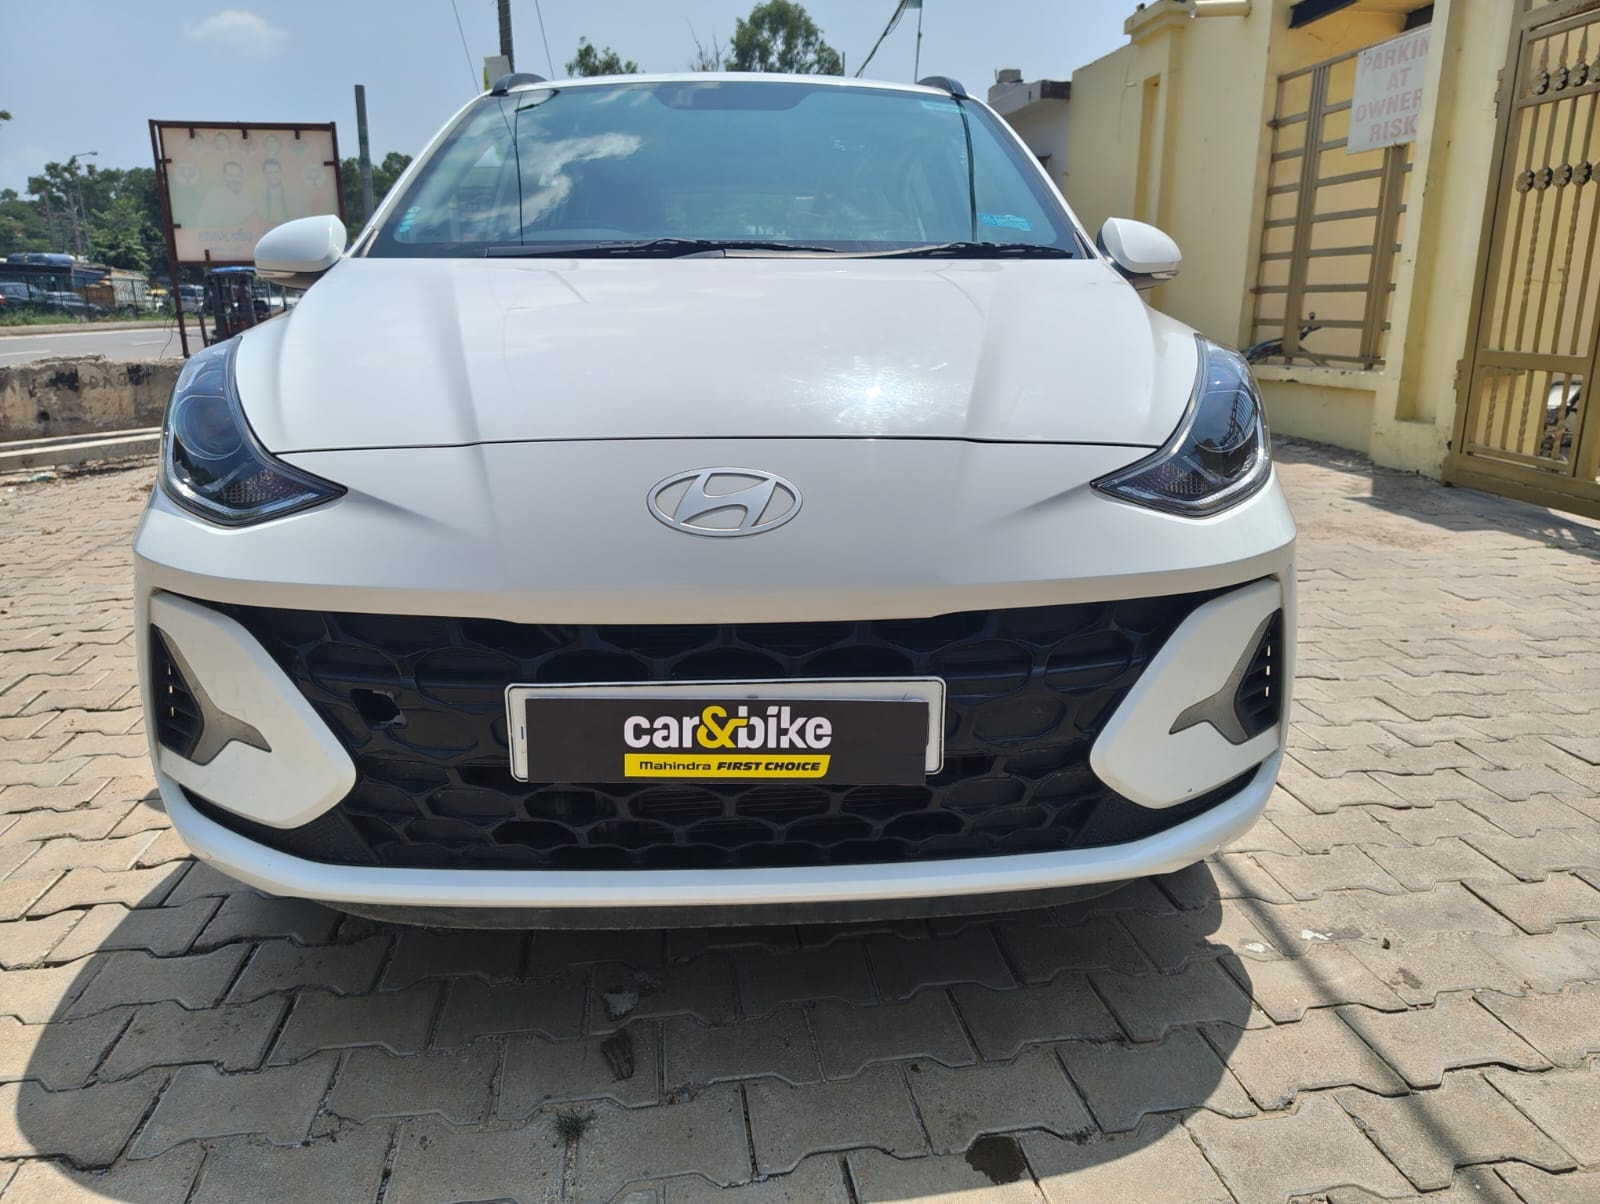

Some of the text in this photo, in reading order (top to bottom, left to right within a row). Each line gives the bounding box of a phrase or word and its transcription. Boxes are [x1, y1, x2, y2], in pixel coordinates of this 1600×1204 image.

[1386, 67, 1412, 91] AT
[1369, 113, 1418, 142] RISK
[624, 705, 832, 749] car&bike
[639, 761, 821, 771] Mahindra FIRST CHOICE
